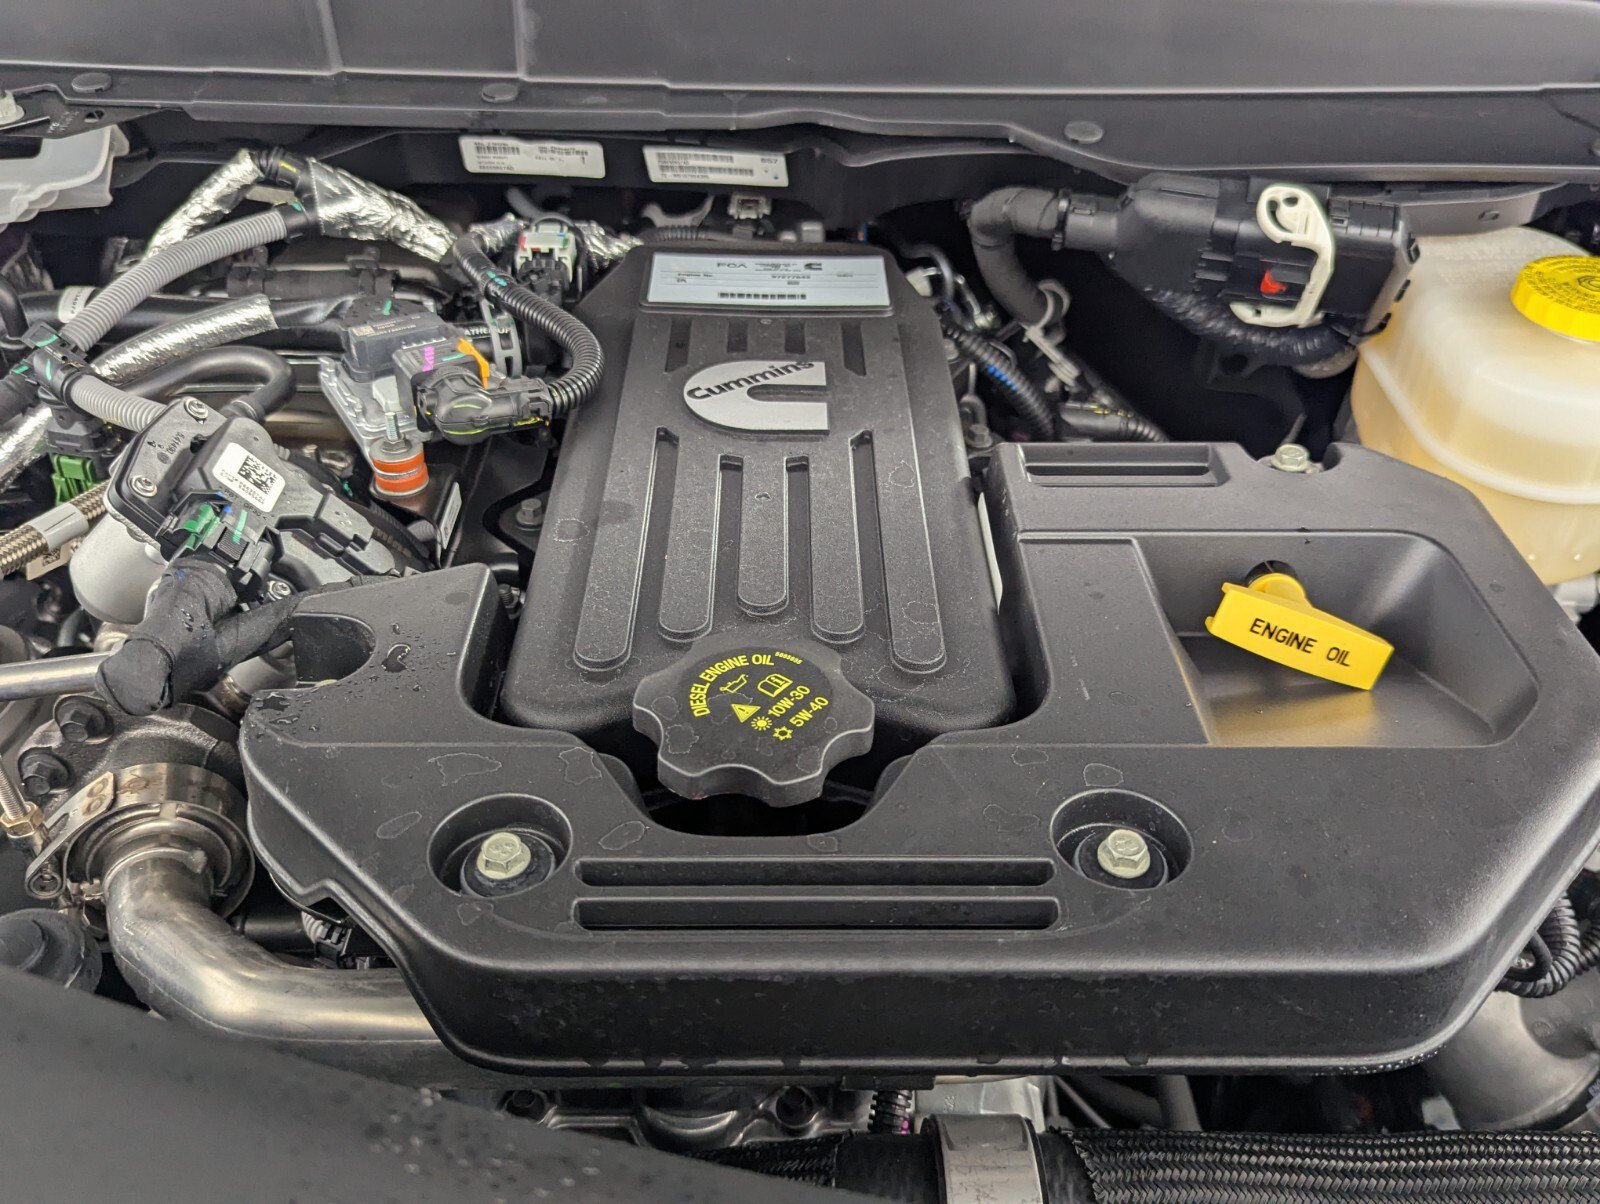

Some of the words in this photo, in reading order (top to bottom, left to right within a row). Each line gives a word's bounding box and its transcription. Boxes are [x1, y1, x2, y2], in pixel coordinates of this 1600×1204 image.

[686, 361, 815, 400] Cummins
[1249, 617, 1318, 654] ENGINE
[1326, 646, 1351, 667] OIL
[699, 654, 750, 682] ENGINE
[751, 654, 775, 666] OIL
[689, 683, 711, 718] DIESEL
[767, 685, 811, 718] 10W-30
[789, 696, 829, 728] 5W-40
